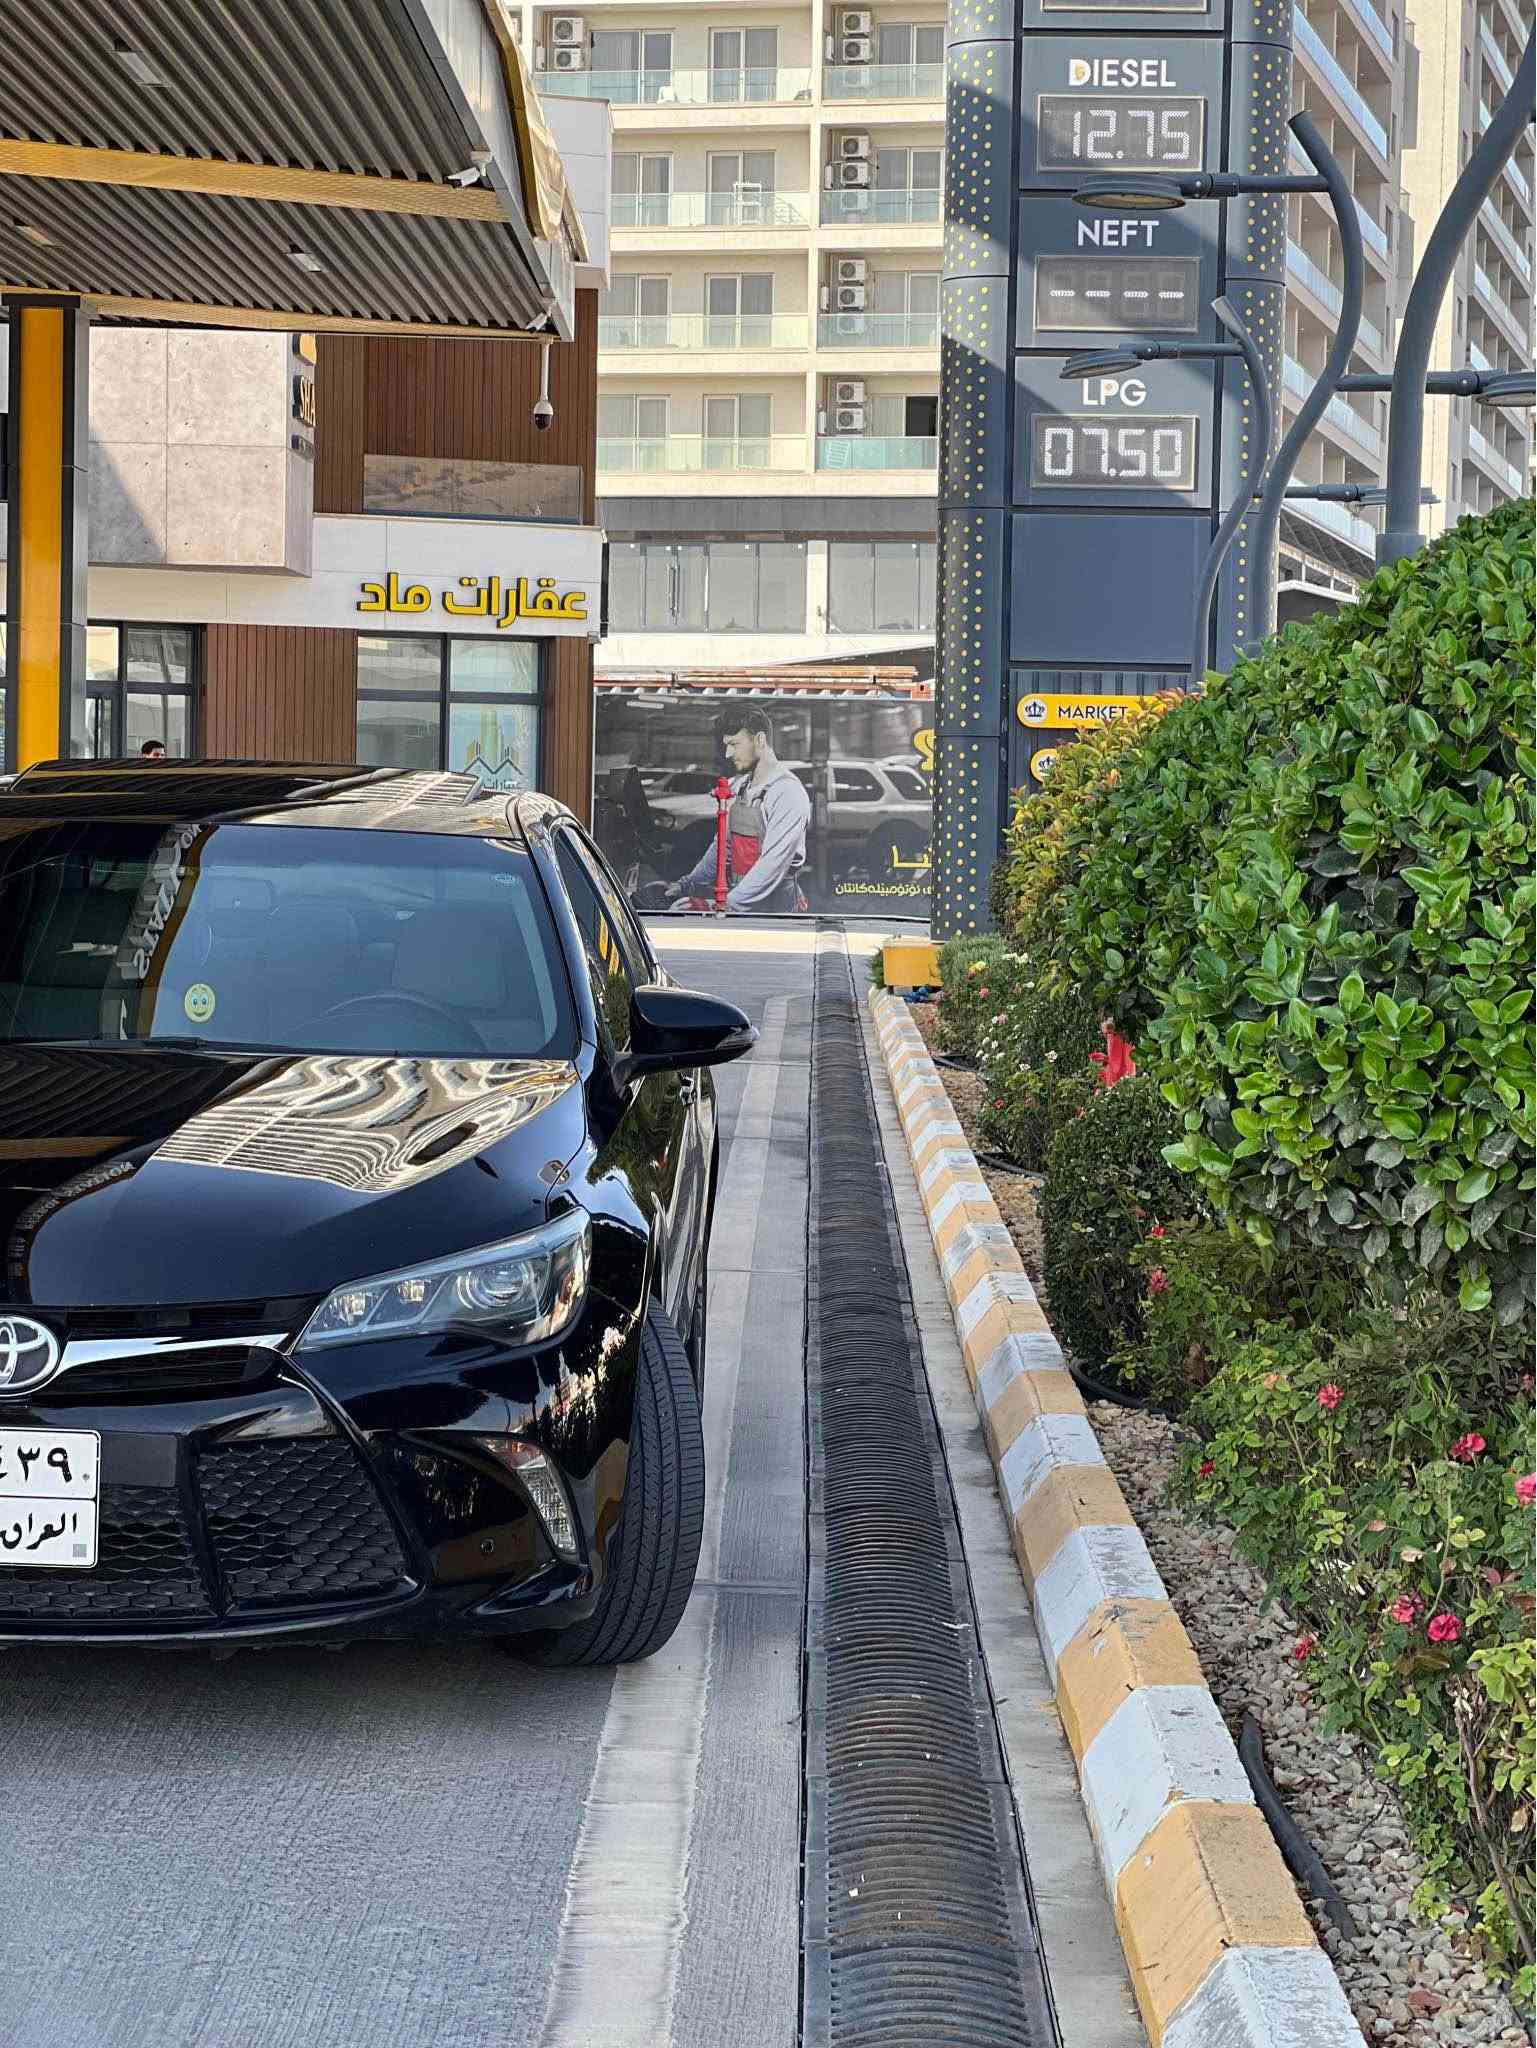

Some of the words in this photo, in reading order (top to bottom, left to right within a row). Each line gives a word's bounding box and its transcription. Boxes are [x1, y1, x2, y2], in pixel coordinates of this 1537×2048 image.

[1068, 58, 1177, 88] DIESEL
[1072, 109, 1191, 160] 12.75
[1077, 220, 1160, 248] NEFT
[1082, 378, 1148, 407] LPG
[1044, 427, 1183, 478] 07.50
[357, 571, 432, 613] ماد
[442, 575, 588, 629] عقارات
[1057, 705, 1129, 720] MARKET
